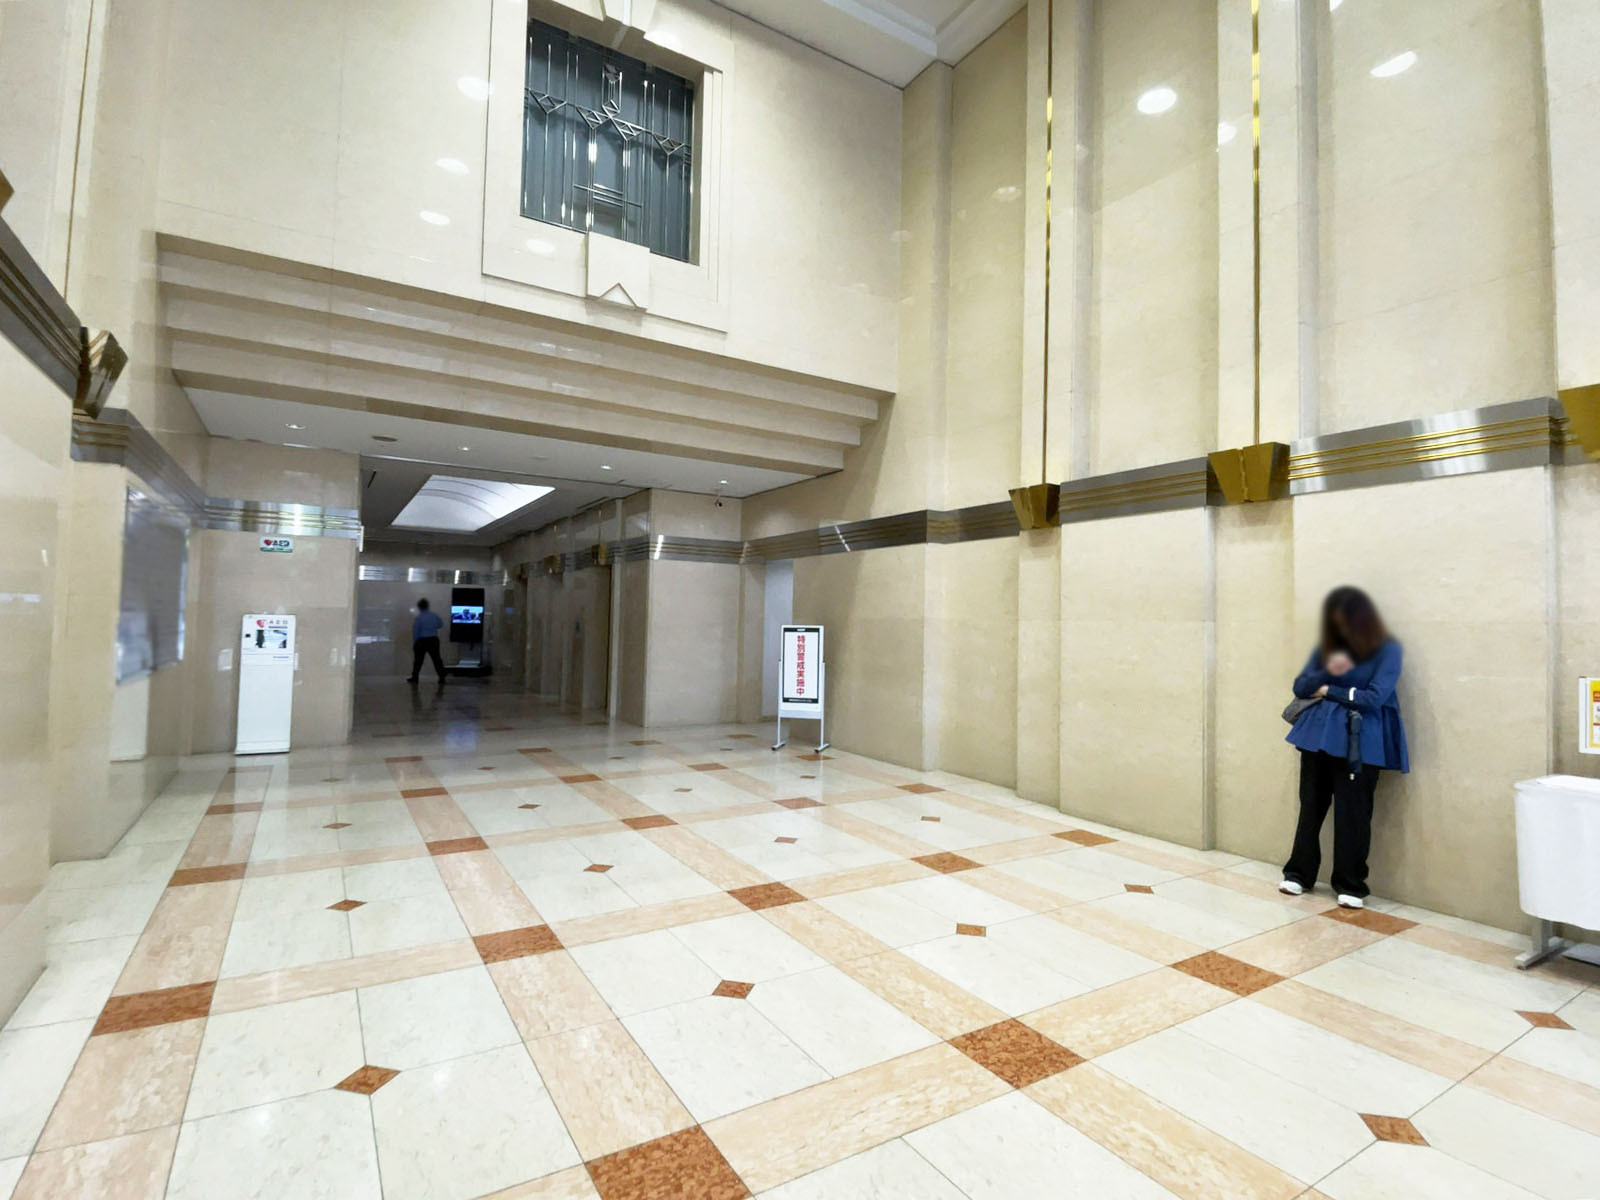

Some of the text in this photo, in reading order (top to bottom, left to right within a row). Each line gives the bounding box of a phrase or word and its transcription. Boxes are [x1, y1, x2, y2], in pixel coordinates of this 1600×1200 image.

[796, 635, 806, 695] 特別警戒実施中
